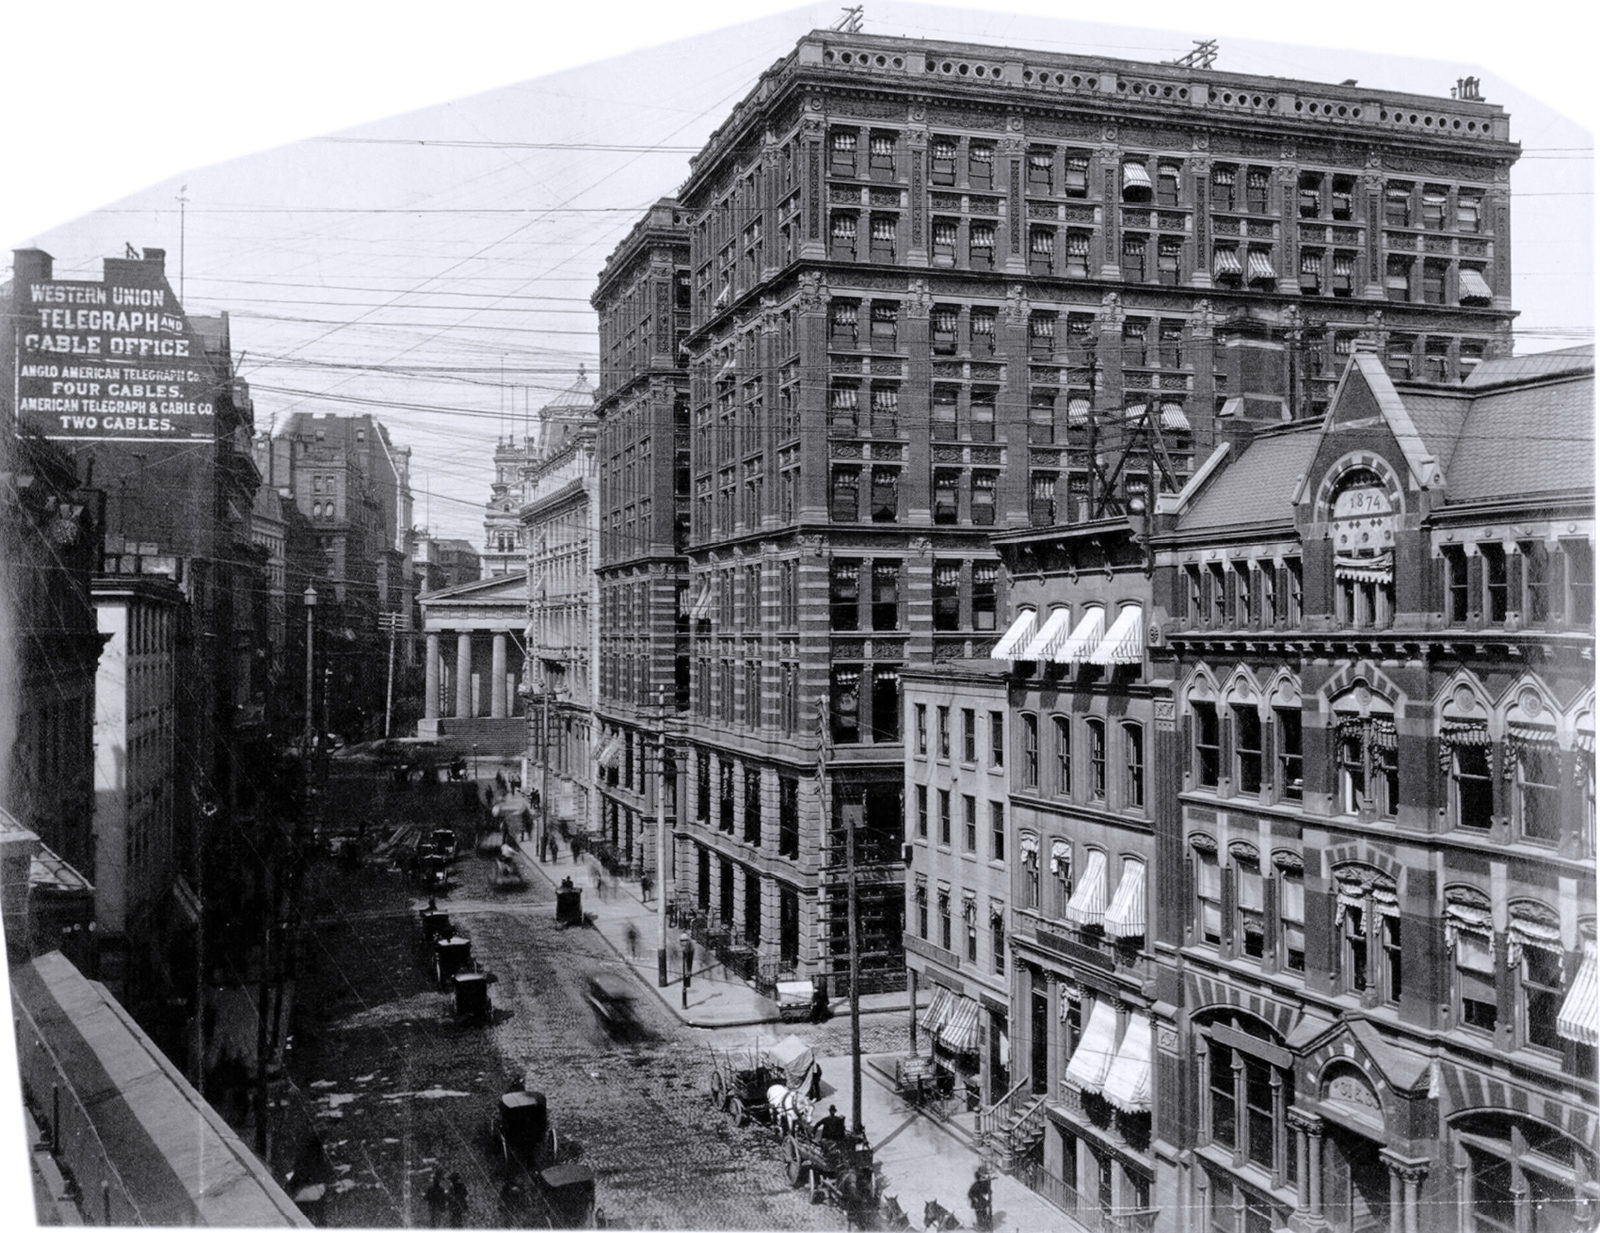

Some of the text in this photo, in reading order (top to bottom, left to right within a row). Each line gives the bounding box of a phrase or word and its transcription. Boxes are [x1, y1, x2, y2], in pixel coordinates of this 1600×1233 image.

[31, 284, 164, 306] WESTERN UNION
[38, 309, 183, 332] TELEGRAPH AND
[25, 334, 189, 357] CABLE OFFICE
[21, 365, 58, 378] ANGLO
[61, 366, 120, 380] AMERICAN
[123, 368, 185, 382] TELEGRAPH
[52, 382, 184, 398] FOUR CABLES.
[20, 398, 215, 416] AMERICAN TELEGRAPH & CABLE CO.
[60, 416, 176, 431] TWO CABLES.
[1350, 492, 1381, 511] 1874
